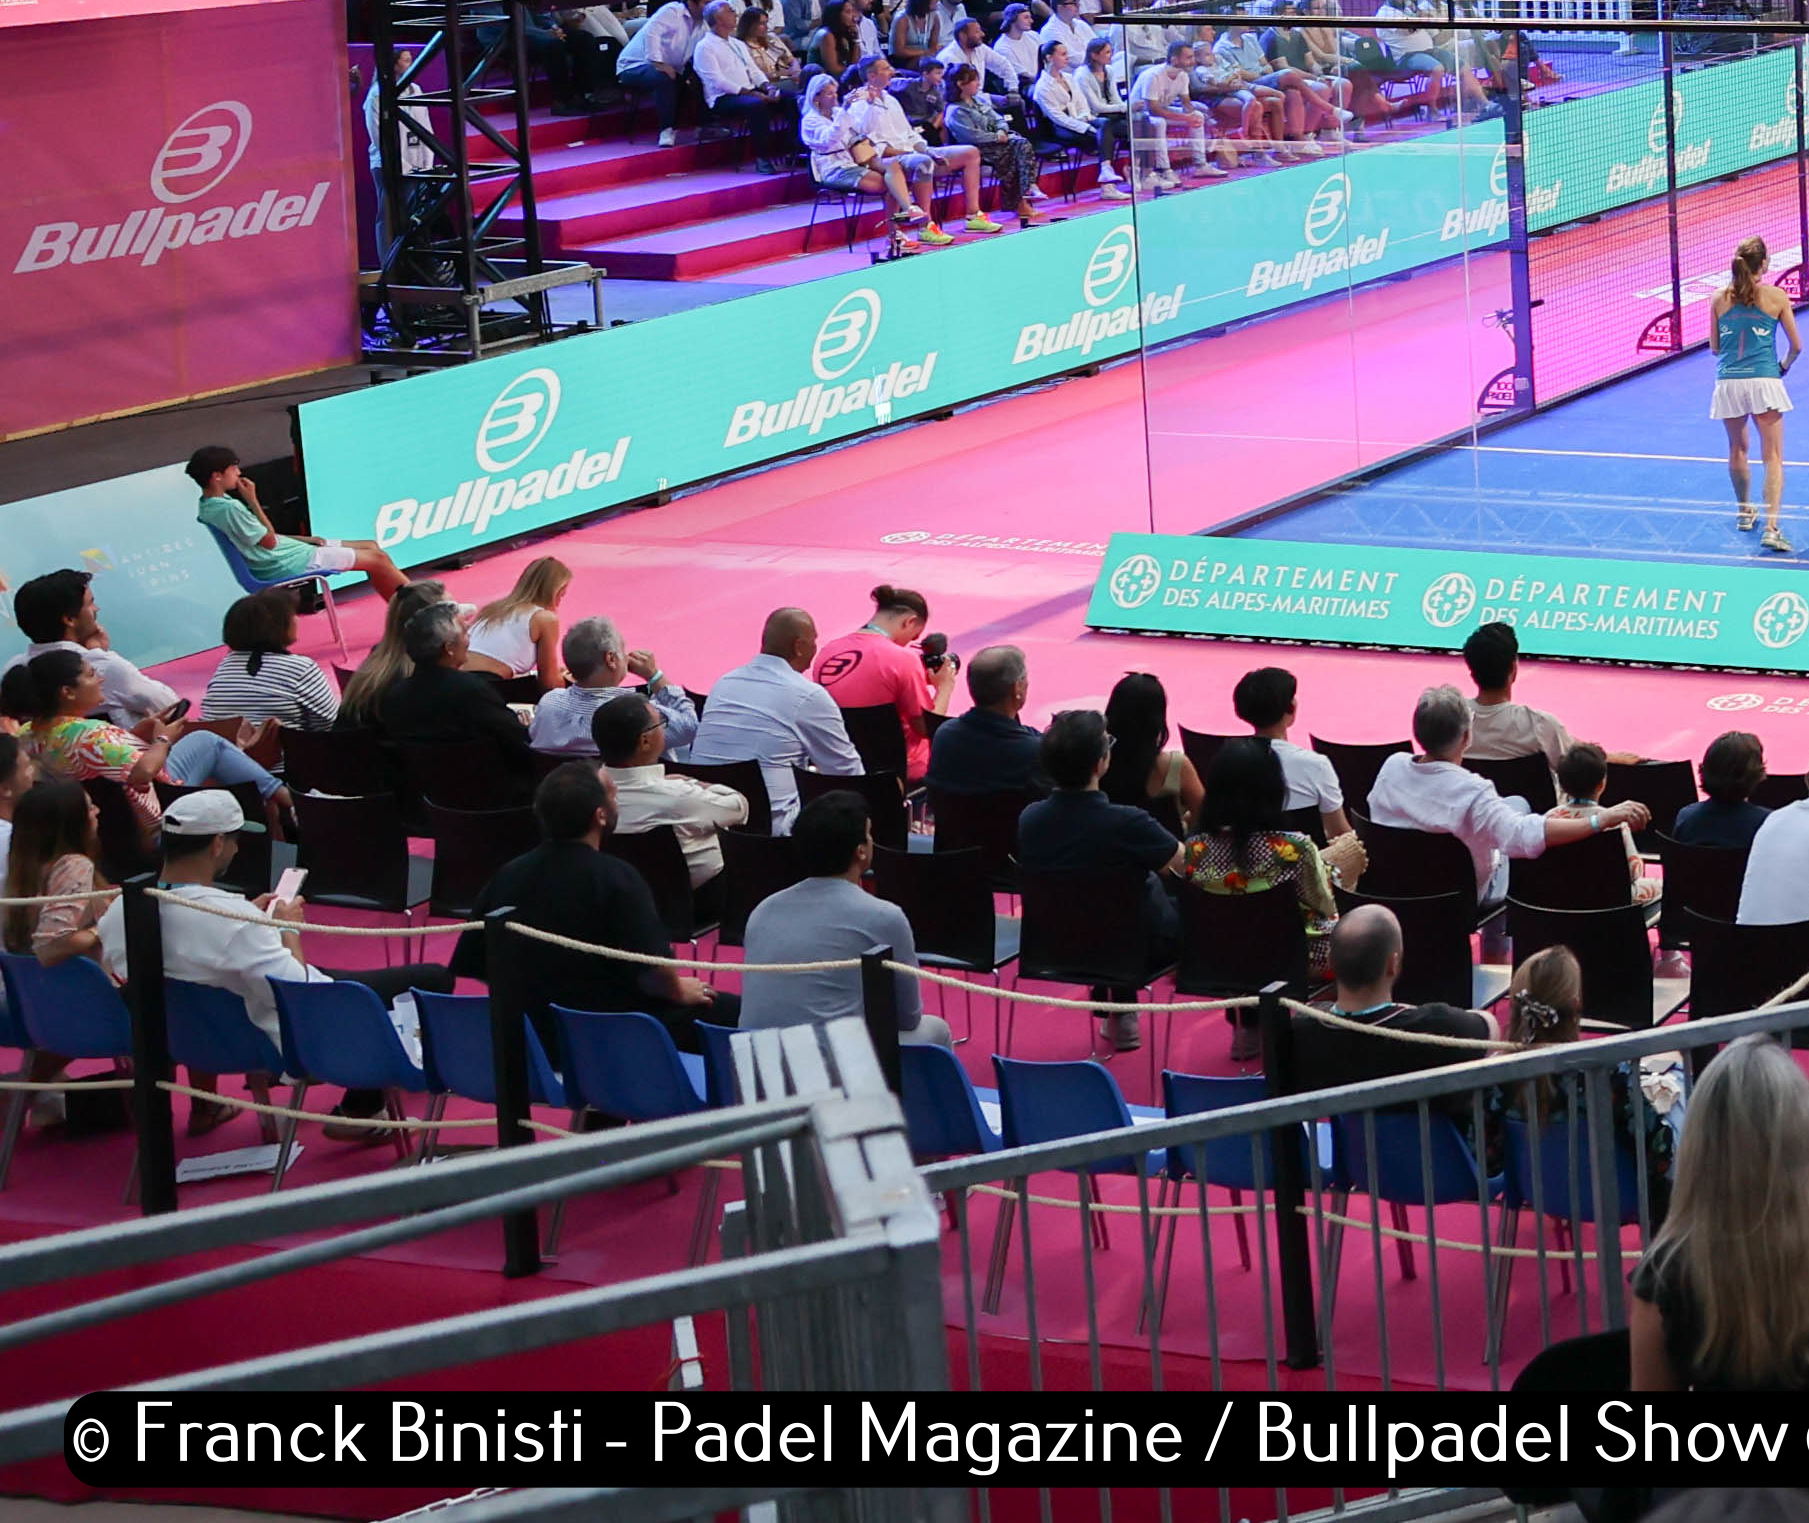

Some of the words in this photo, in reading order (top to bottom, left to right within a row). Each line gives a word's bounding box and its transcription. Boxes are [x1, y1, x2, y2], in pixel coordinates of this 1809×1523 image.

[13, 181, 331, 275] Bullpadel
[1246, 227, 1390, 297] Bullpadel
[1011, 283, 1186, 365] Bullpadel
[723, 351, 938, 449] Bullpadel
[375, 436, 632, 550] Bullpadel
[1162, 587, 1202, 608] DES
[1205, 590, 1392, 621] ALPES-MARITIMES
[1168, 556, 1400, 594] DÉPARTEMENT
[1485, 573, 1728, 614] DÉPARTEMENT
[1478, 605, 1519, 629] DES
[1522, 608, 1721, 641] ALPES-MARITIMES
